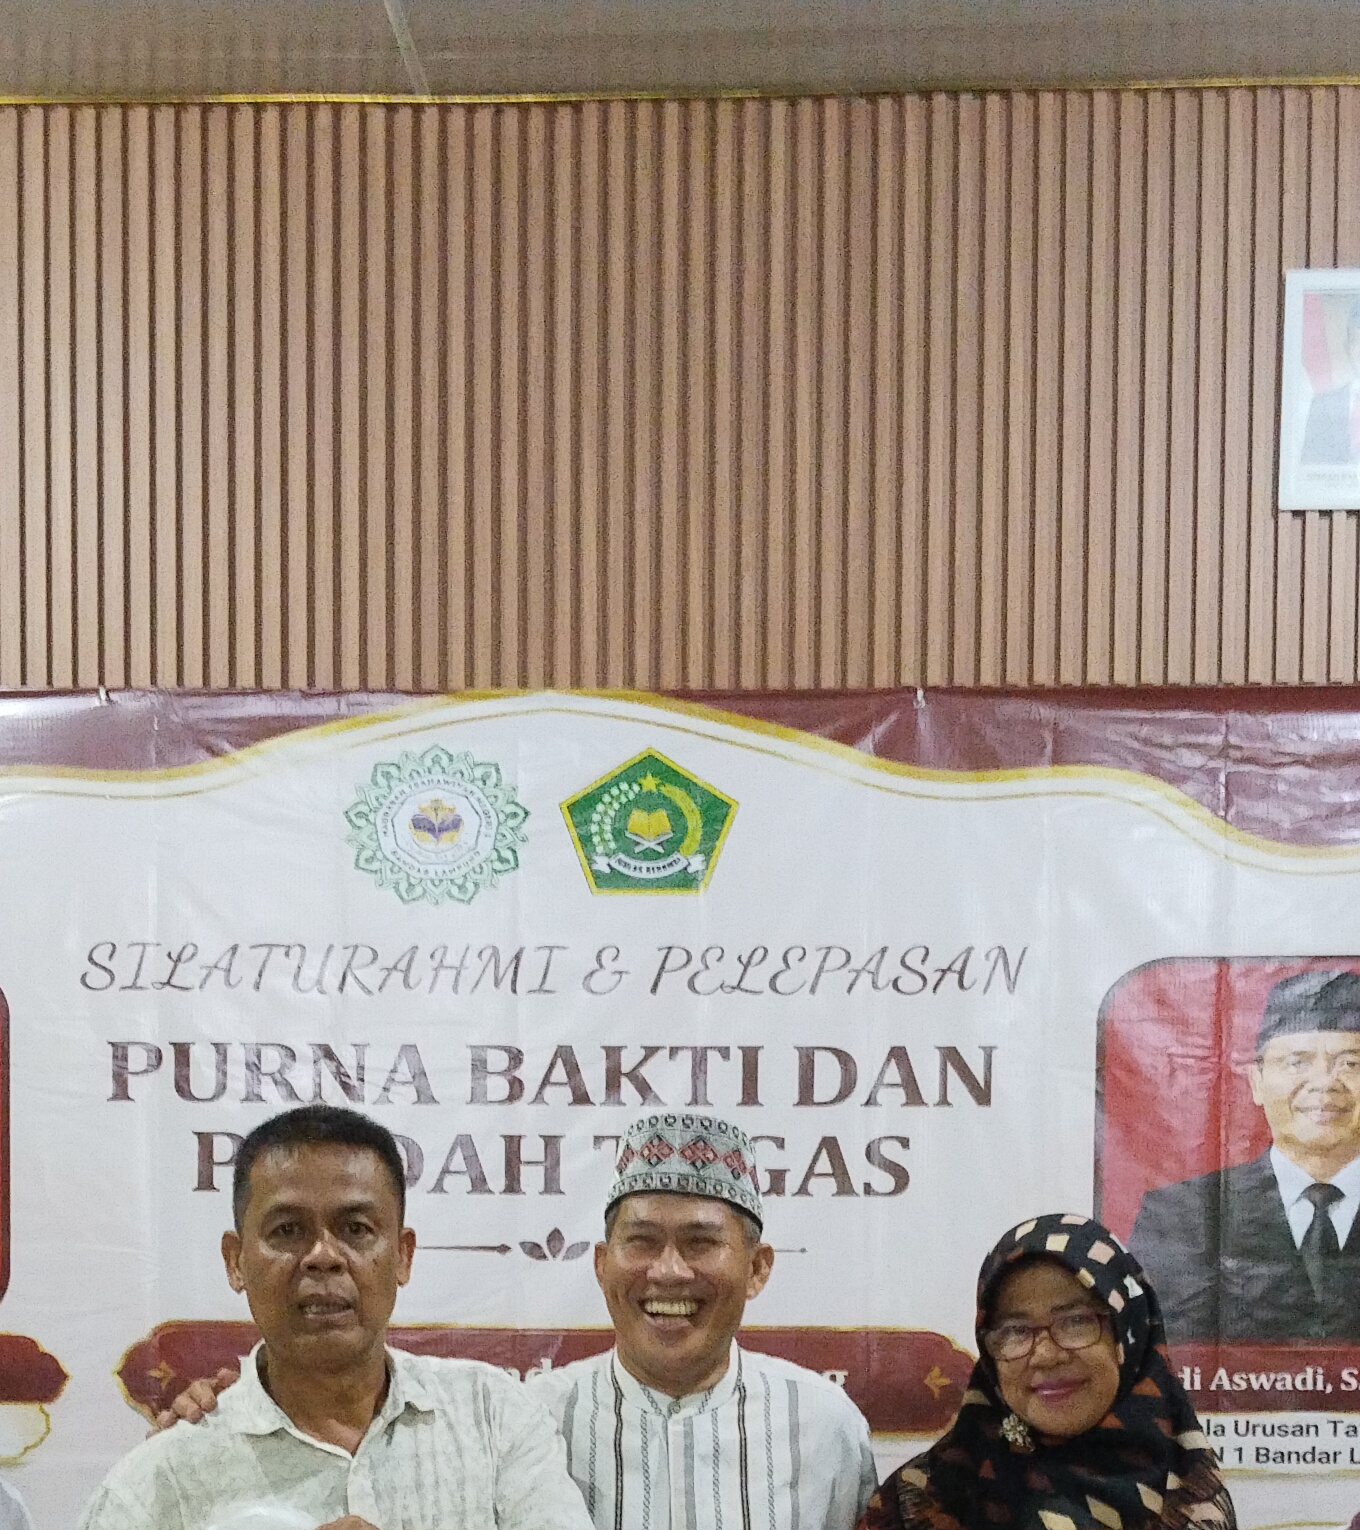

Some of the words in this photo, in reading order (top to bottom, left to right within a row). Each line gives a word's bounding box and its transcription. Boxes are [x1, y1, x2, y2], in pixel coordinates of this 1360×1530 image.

[80, 940, 568, 997] SILATURAHMI
[582, 944, 630, 996] &
[650, 944, 1029, 996] PELEPASAN
[106, 1040, 440, 1106] PURNA
[466, 1043, 765, 1108] BAKTI
[792, 1045, 998, 1108] DAN
[1209, 1366, 1333, 1394] Aswadi,
[1234, 1419, 1319, 1438] Urusan
[1255, 1446, 1342, 1465] Bandar
